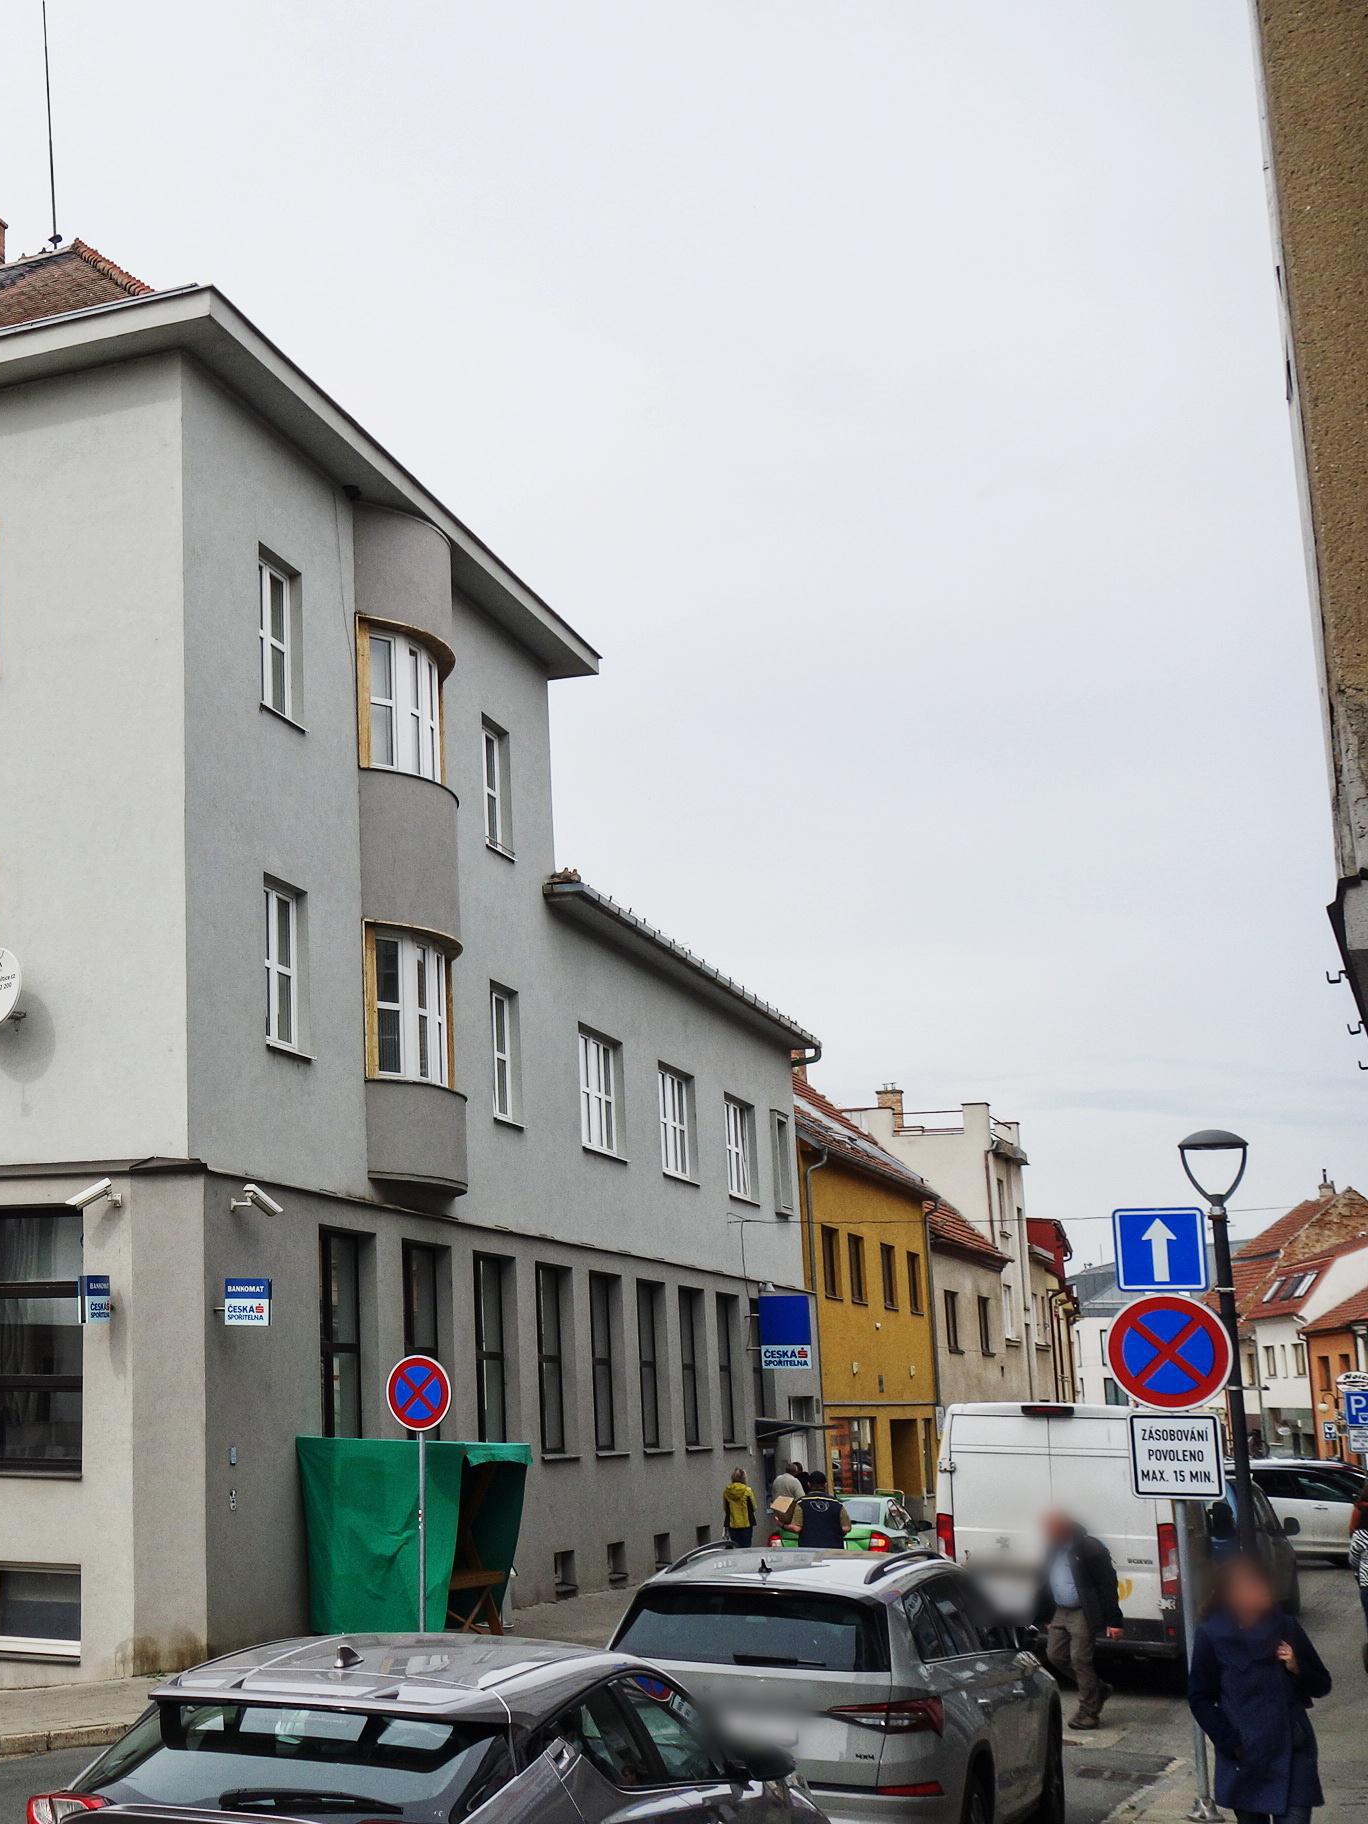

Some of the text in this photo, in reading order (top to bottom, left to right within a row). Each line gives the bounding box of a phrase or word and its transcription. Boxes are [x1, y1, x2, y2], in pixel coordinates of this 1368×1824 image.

[227, 1285, 264, 1293] BANKOMAT
[227, 1304, 255, 1314] ČESKÁ
[763, 1348, 797, 1359] ČESKÁ
[764, 1359, 809, 1367] SPOŘITELNA
[1141, 1426, 1209, 1442] ZÁSOBOVÁNÍ
[1148, 1449, 1204, 1462] POVOLENO
[1141, 1469, 1215, 1483] MAX. 15 MIN.
